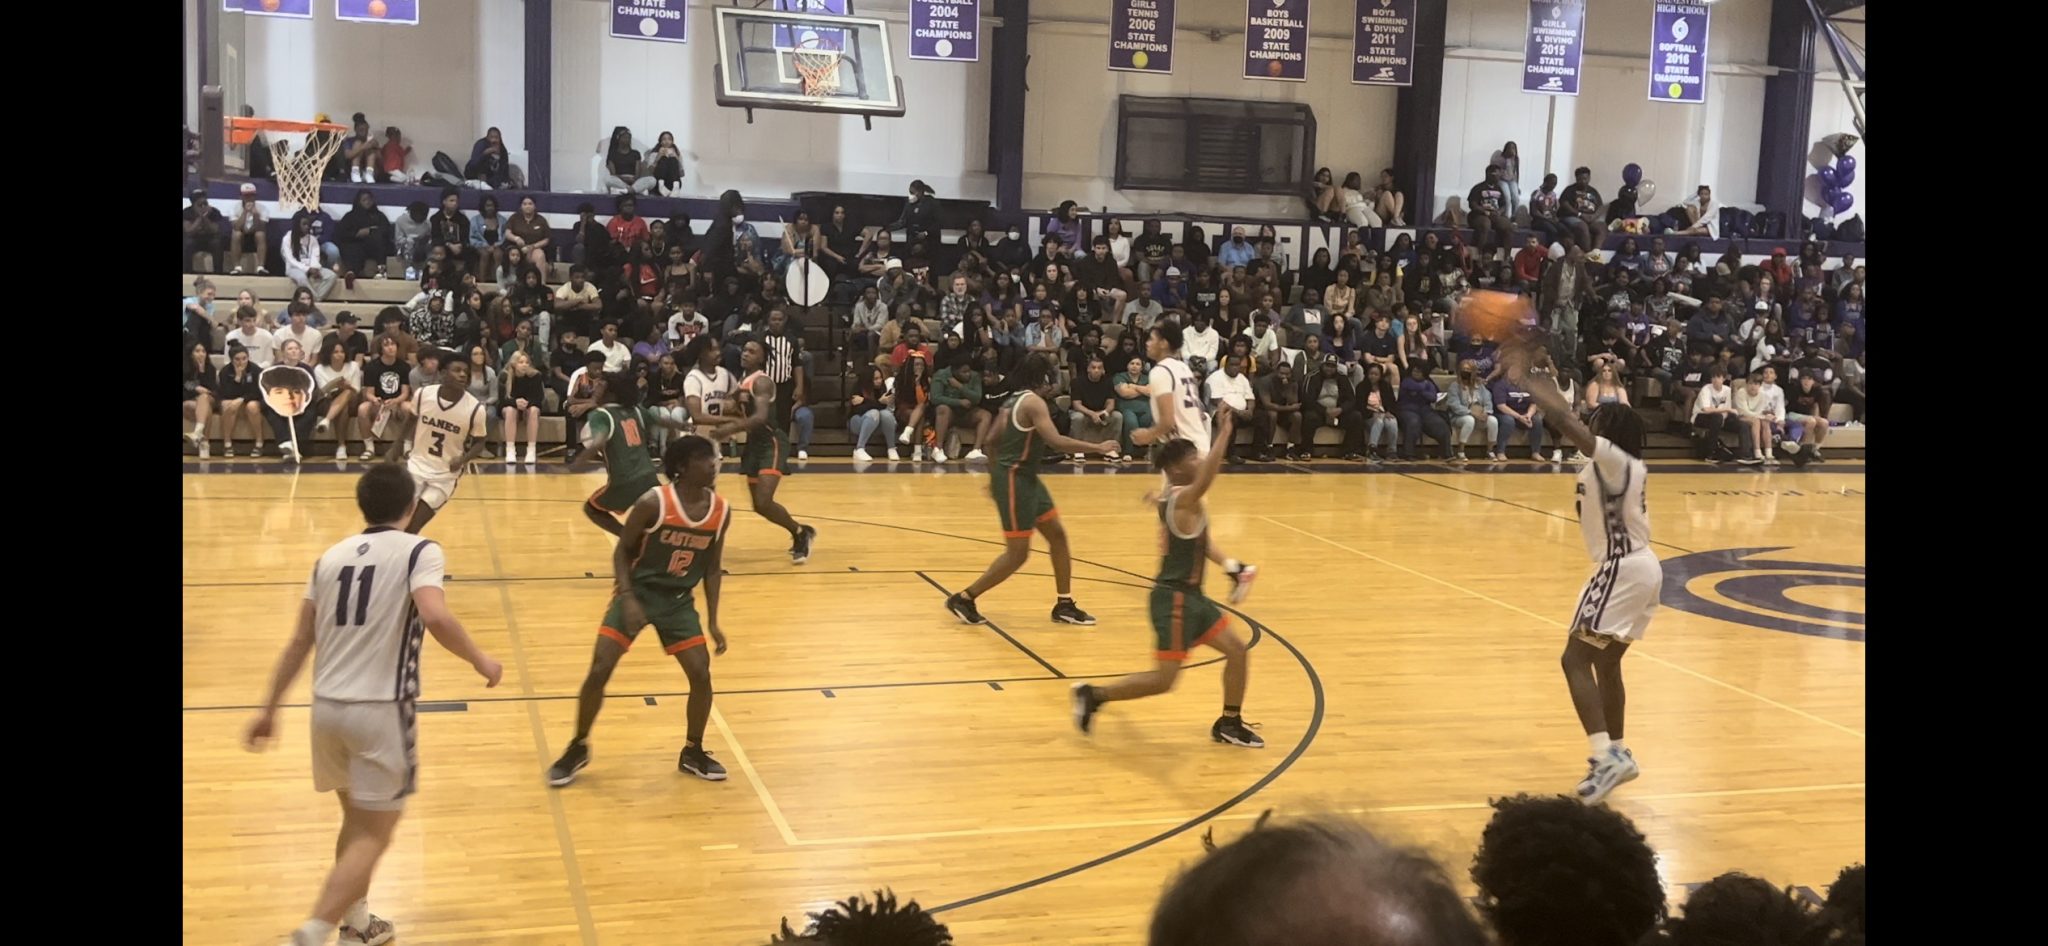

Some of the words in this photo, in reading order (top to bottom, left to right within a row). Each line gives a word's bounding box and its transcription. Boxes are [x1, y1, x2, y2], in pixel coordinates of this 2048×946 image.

[633, 0, 666, 8] STATE
[1131, 0, 1156, 9] GIRLS
[618, 6, 680, 19] CHAMPIONS
[930, 5, 959, 18] 2004
[1128, 9, 1159, 18] TENNIS
[1267, 10, 1289, 18] BOYS
[1657, 4, 1675, 13] HIGH
[1677, 5, 1706, 15] SCHOOL
[929, 20, 959, 29] STATE
[1129, 18, 1155, 30] 2006
[1251, 17, 1304, 28] BASKETBALL
[1361, 16, 1407, 25] SWIMMING
[1542, 20, 1566, 28] GIRLS
[1264, 28, 1290, 40] 2009
[1374, 25, 1404, 33] DIVING
[1533, 27, 1576, 37] SWIMMING
[916, 29, 972, 40] CHAMPIONS
[1128, 33, 1155, 42] STATE
[1371, 33, 1396, 45] 2011
[1545, 36, 1573, 44] DIVING
[1114, 41, 1168, 52] CHAMPIONS
[1263, 42, 1290, 50] STATE
[1370, 47, 1395, 55] STATE
[1541, 44, 1566, 56] 2015
[1659, 43, 1697, 53] SOFTBALL
[1250, 50, 1301, 61] CHAMPIONS
[1357, 56, 1407, 65] CHAMPIONS
[1666, 53, 1689, 65] 2016
[1540, 57, 1564, 66] STATE
[1528, 65, 1575, 76] CHAMPIONS
[1665, 66, 1689, 74] STATE
[1654, 74, 1699, 84] CHAMPIONS
[422, 415, 460, 434] CANES
[620, 418, 641, 447] 10
[428, 431, 445, 457] 3
[667, 550, 695, 577] 12
[336, 565, 376, 626] 11
